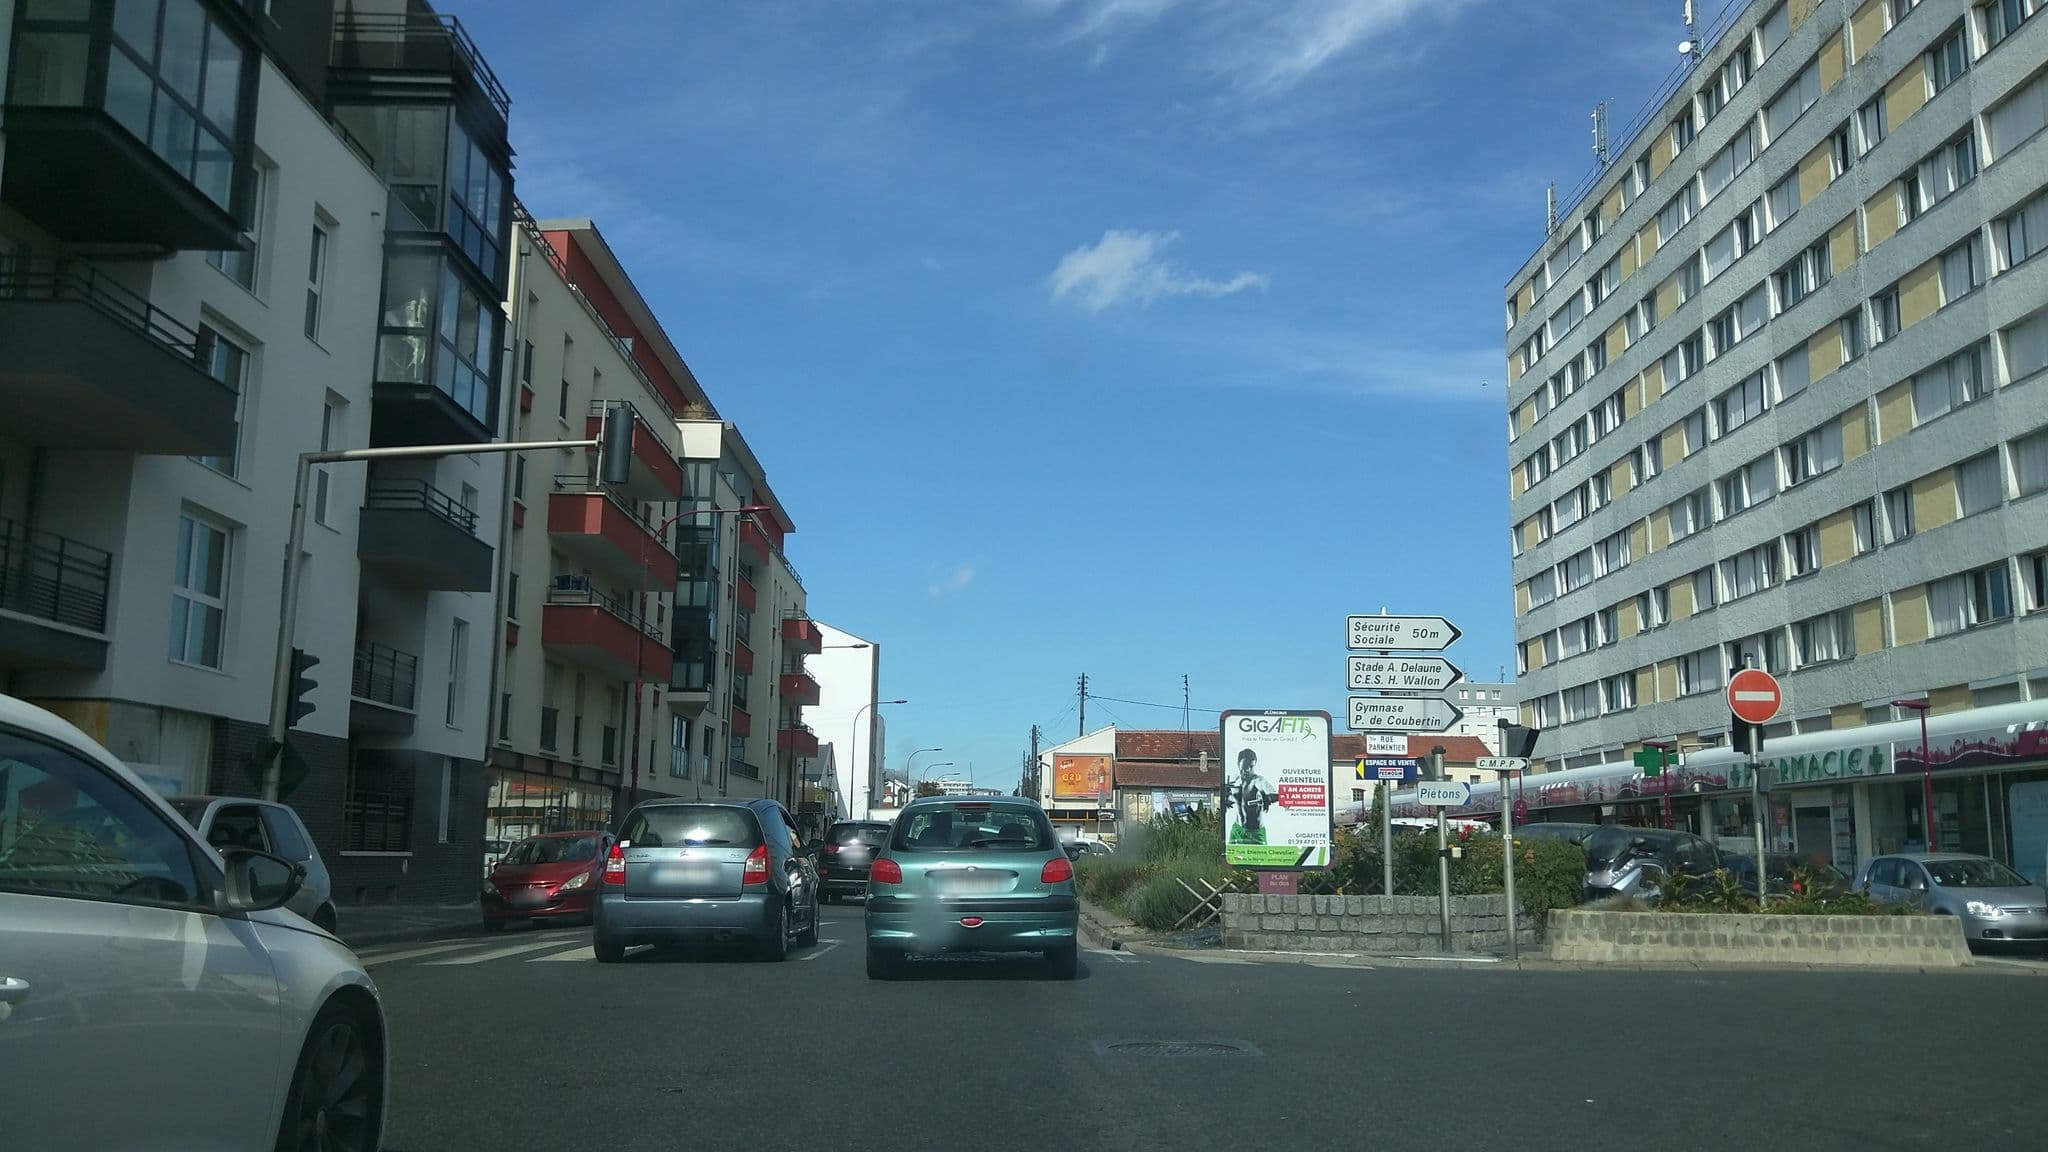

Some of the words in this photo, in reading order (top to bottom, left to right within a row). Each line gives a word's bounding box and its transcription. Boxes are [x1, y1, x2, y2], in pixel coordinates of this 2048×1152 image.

[1354, 622, 1400, 632] Sécurité
[1354, 634, 1395, 644] Sociale
[1412, 628, 1428, 639] 50
[1429, 631, 1439, 639] m
[1354, 662, 1384, 672] Stade
[1387, 662, 1397, 672] A.
[1401, 662, 1442, 673] Delaune
[1354, 674, 1384, 685] C.E.S.
[1388, 675, 1398, 685] H.
[1404, 675, 1440, 686] Wallon
[1355, 702, 1404, 714] Gymnase
[1354, 714, 1364, 725] P.
[1370, 715, 1382, 725] de
[1387, 715, 1441, 726] Coubertin
[1381, 735, 1394, 743] RUE
[1369, 743, 1406, 752] PARMENTIER
[1744, 748, 1864, 786] PRMACIE
[1279, 776, 1325, 784] ARGENTEUIL
